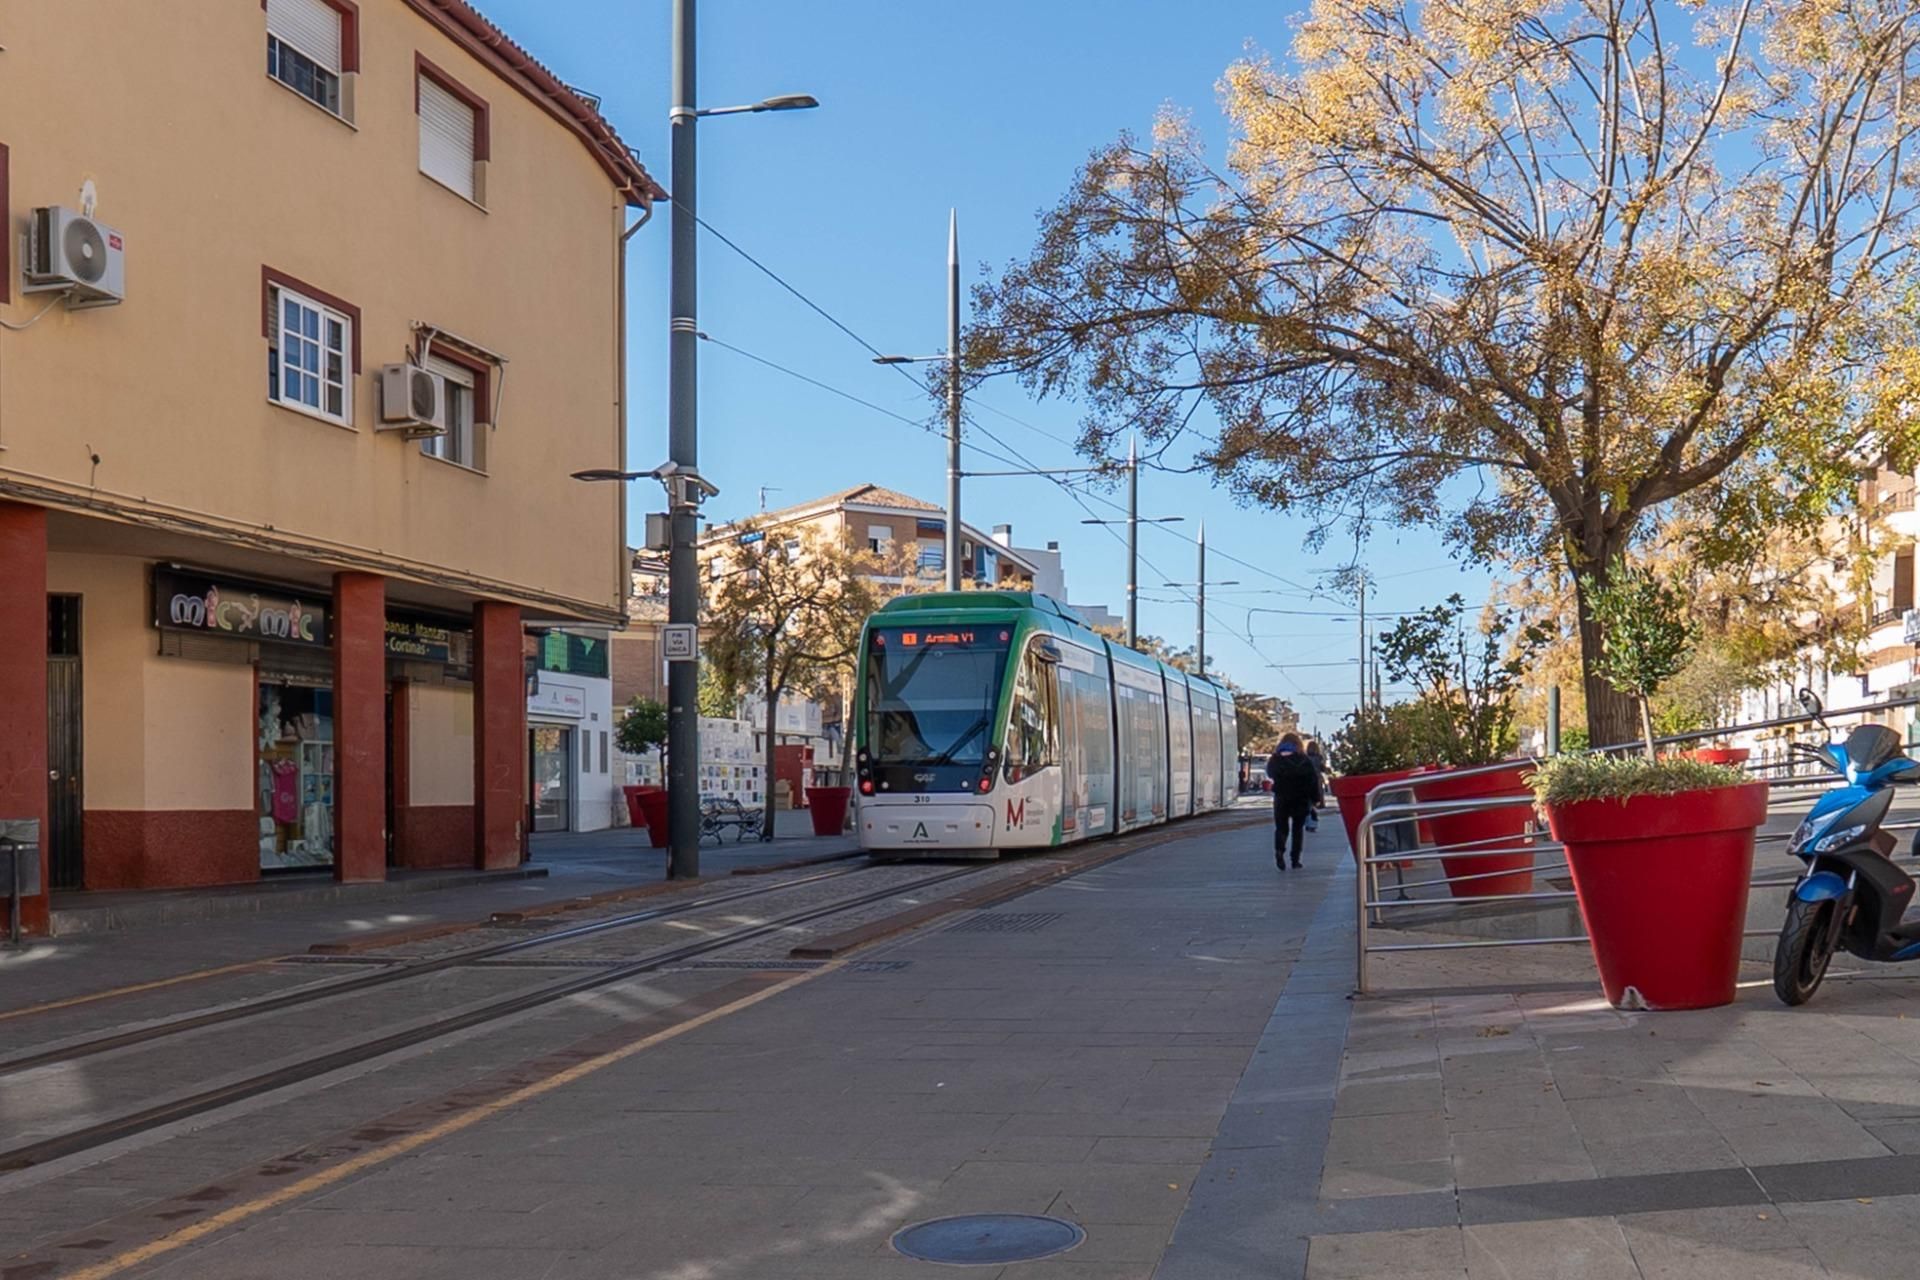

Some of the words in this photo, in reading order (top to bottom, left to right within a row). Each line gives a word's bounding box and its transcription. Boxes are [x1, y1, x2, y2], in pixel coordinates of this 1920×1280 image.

[925, 634, 959, 643] Armilla
[961, 633, 974, 642] V1
[914, 795, 930, 803] 310
